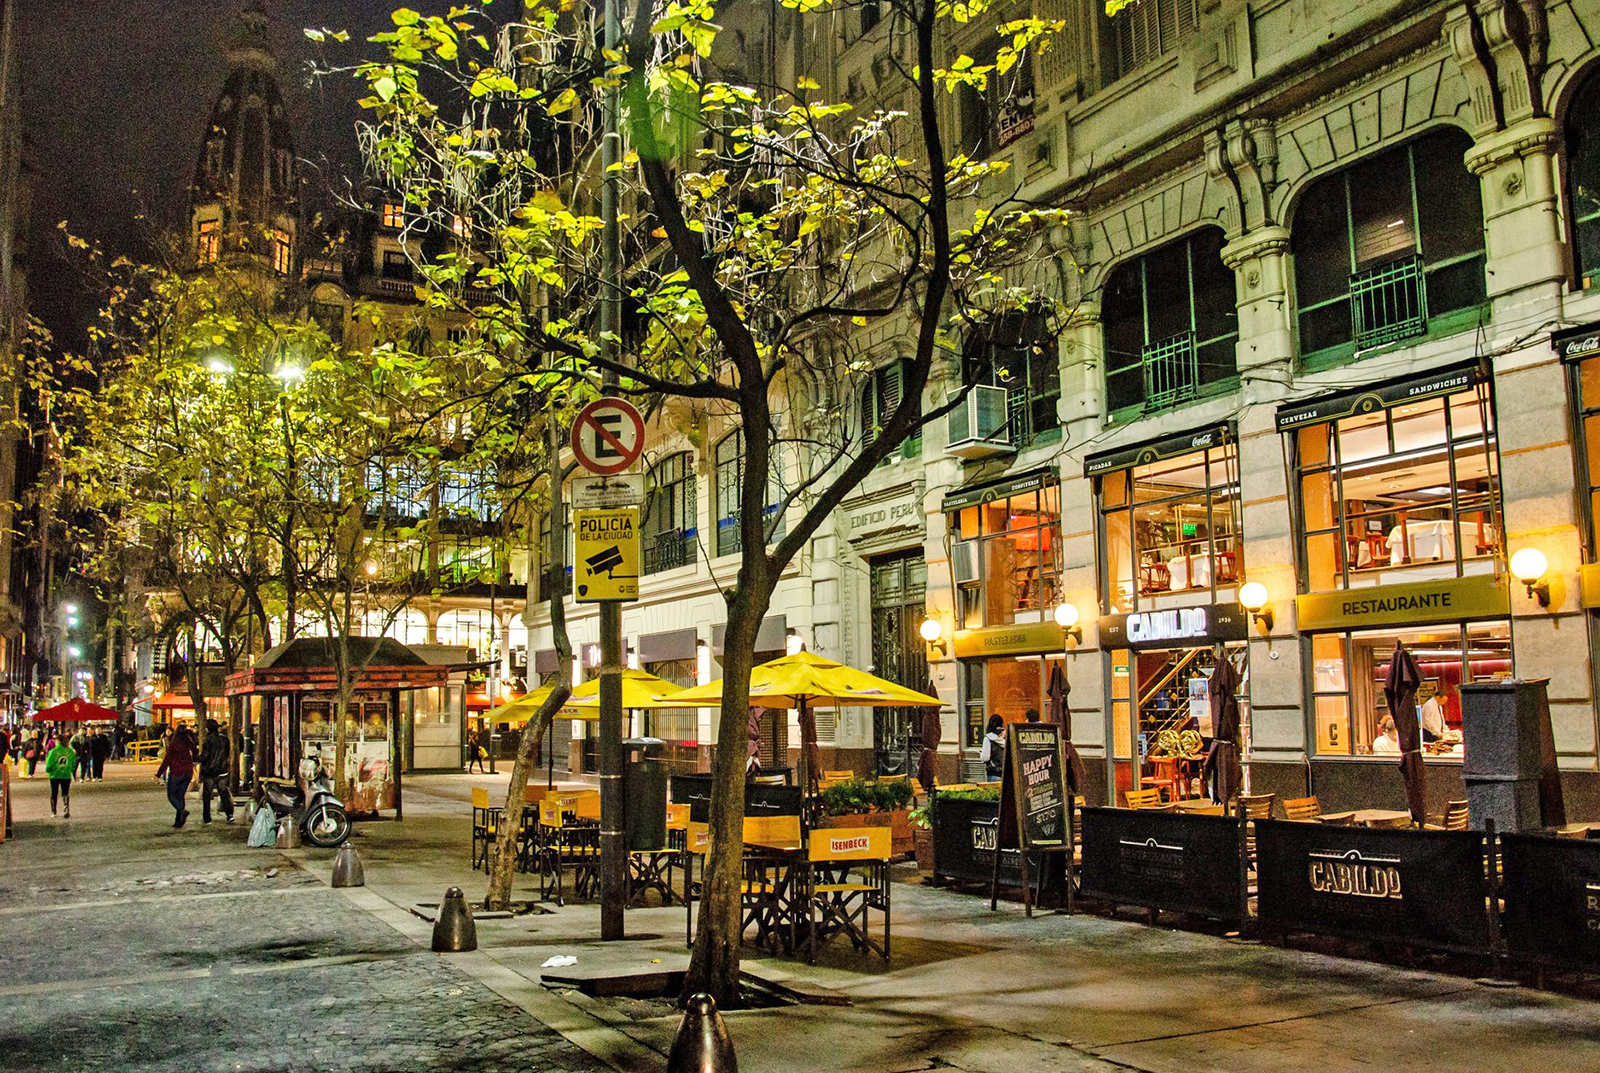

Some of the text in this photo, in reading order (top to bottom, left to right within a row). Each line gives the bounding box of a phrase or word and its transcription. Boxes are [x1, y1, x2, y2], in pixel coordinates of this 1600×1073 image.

[1409, 376, 1468, 395] SANDWICHES
[1280, 410, 1318, 425] CERVEZAS
[594, 414, 622, 458] E
[1089, 461, 1112, 471] PICADAS
[580, 517, 632, 532] POLICIA
[851, 509, 886, 529] EDIFICIO
[580, 531, 633, 541] DE LA CIUDAD
[1342, 592, 1451, 615] RESTAURANTE
[1126, 607, 1208, 642] CABILDO
[1023, 754, 1053, 776] HAPPY
[1028, 769, 1050, 786] HOUR
[831, 838, 868, 851] ISENBECK
[1309, 861, 1403, 900] CABILDO
